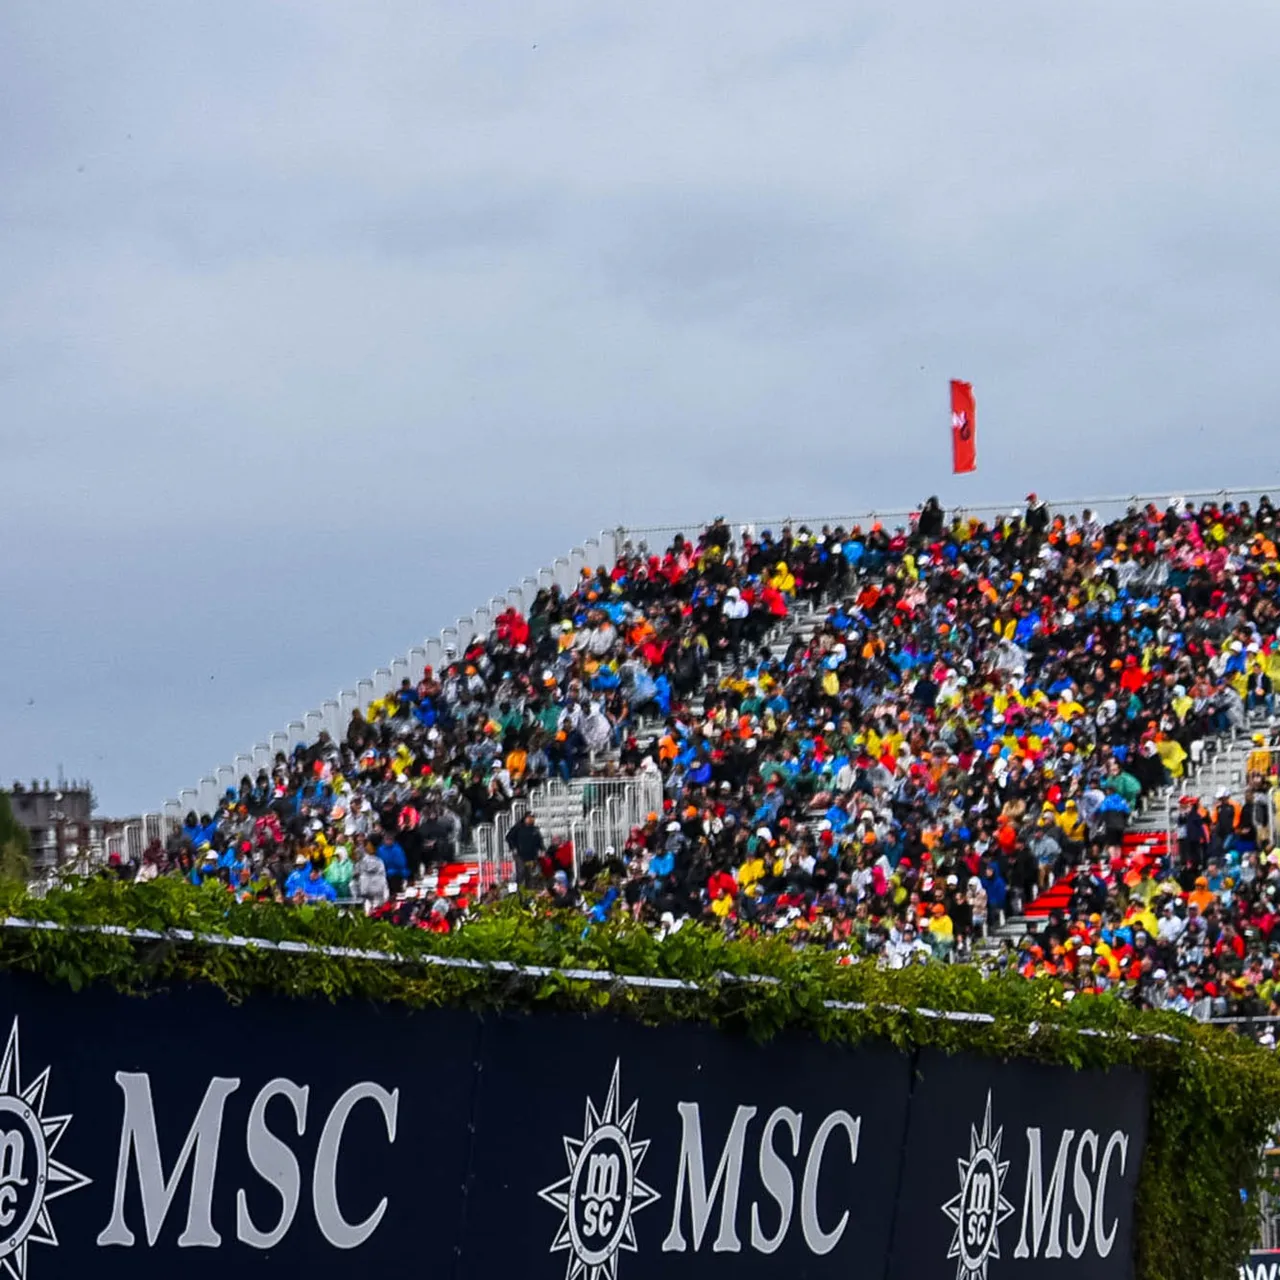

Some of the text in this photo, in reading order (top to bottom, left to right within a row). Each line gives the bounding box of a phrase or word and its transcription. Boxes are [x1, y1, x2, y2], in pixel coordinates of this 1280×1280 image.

[97, 1071, 399, 1248] MSC
[662, 1102, 860, 1254] MSC
[1014, 1128, 1128, 1258] MSC
